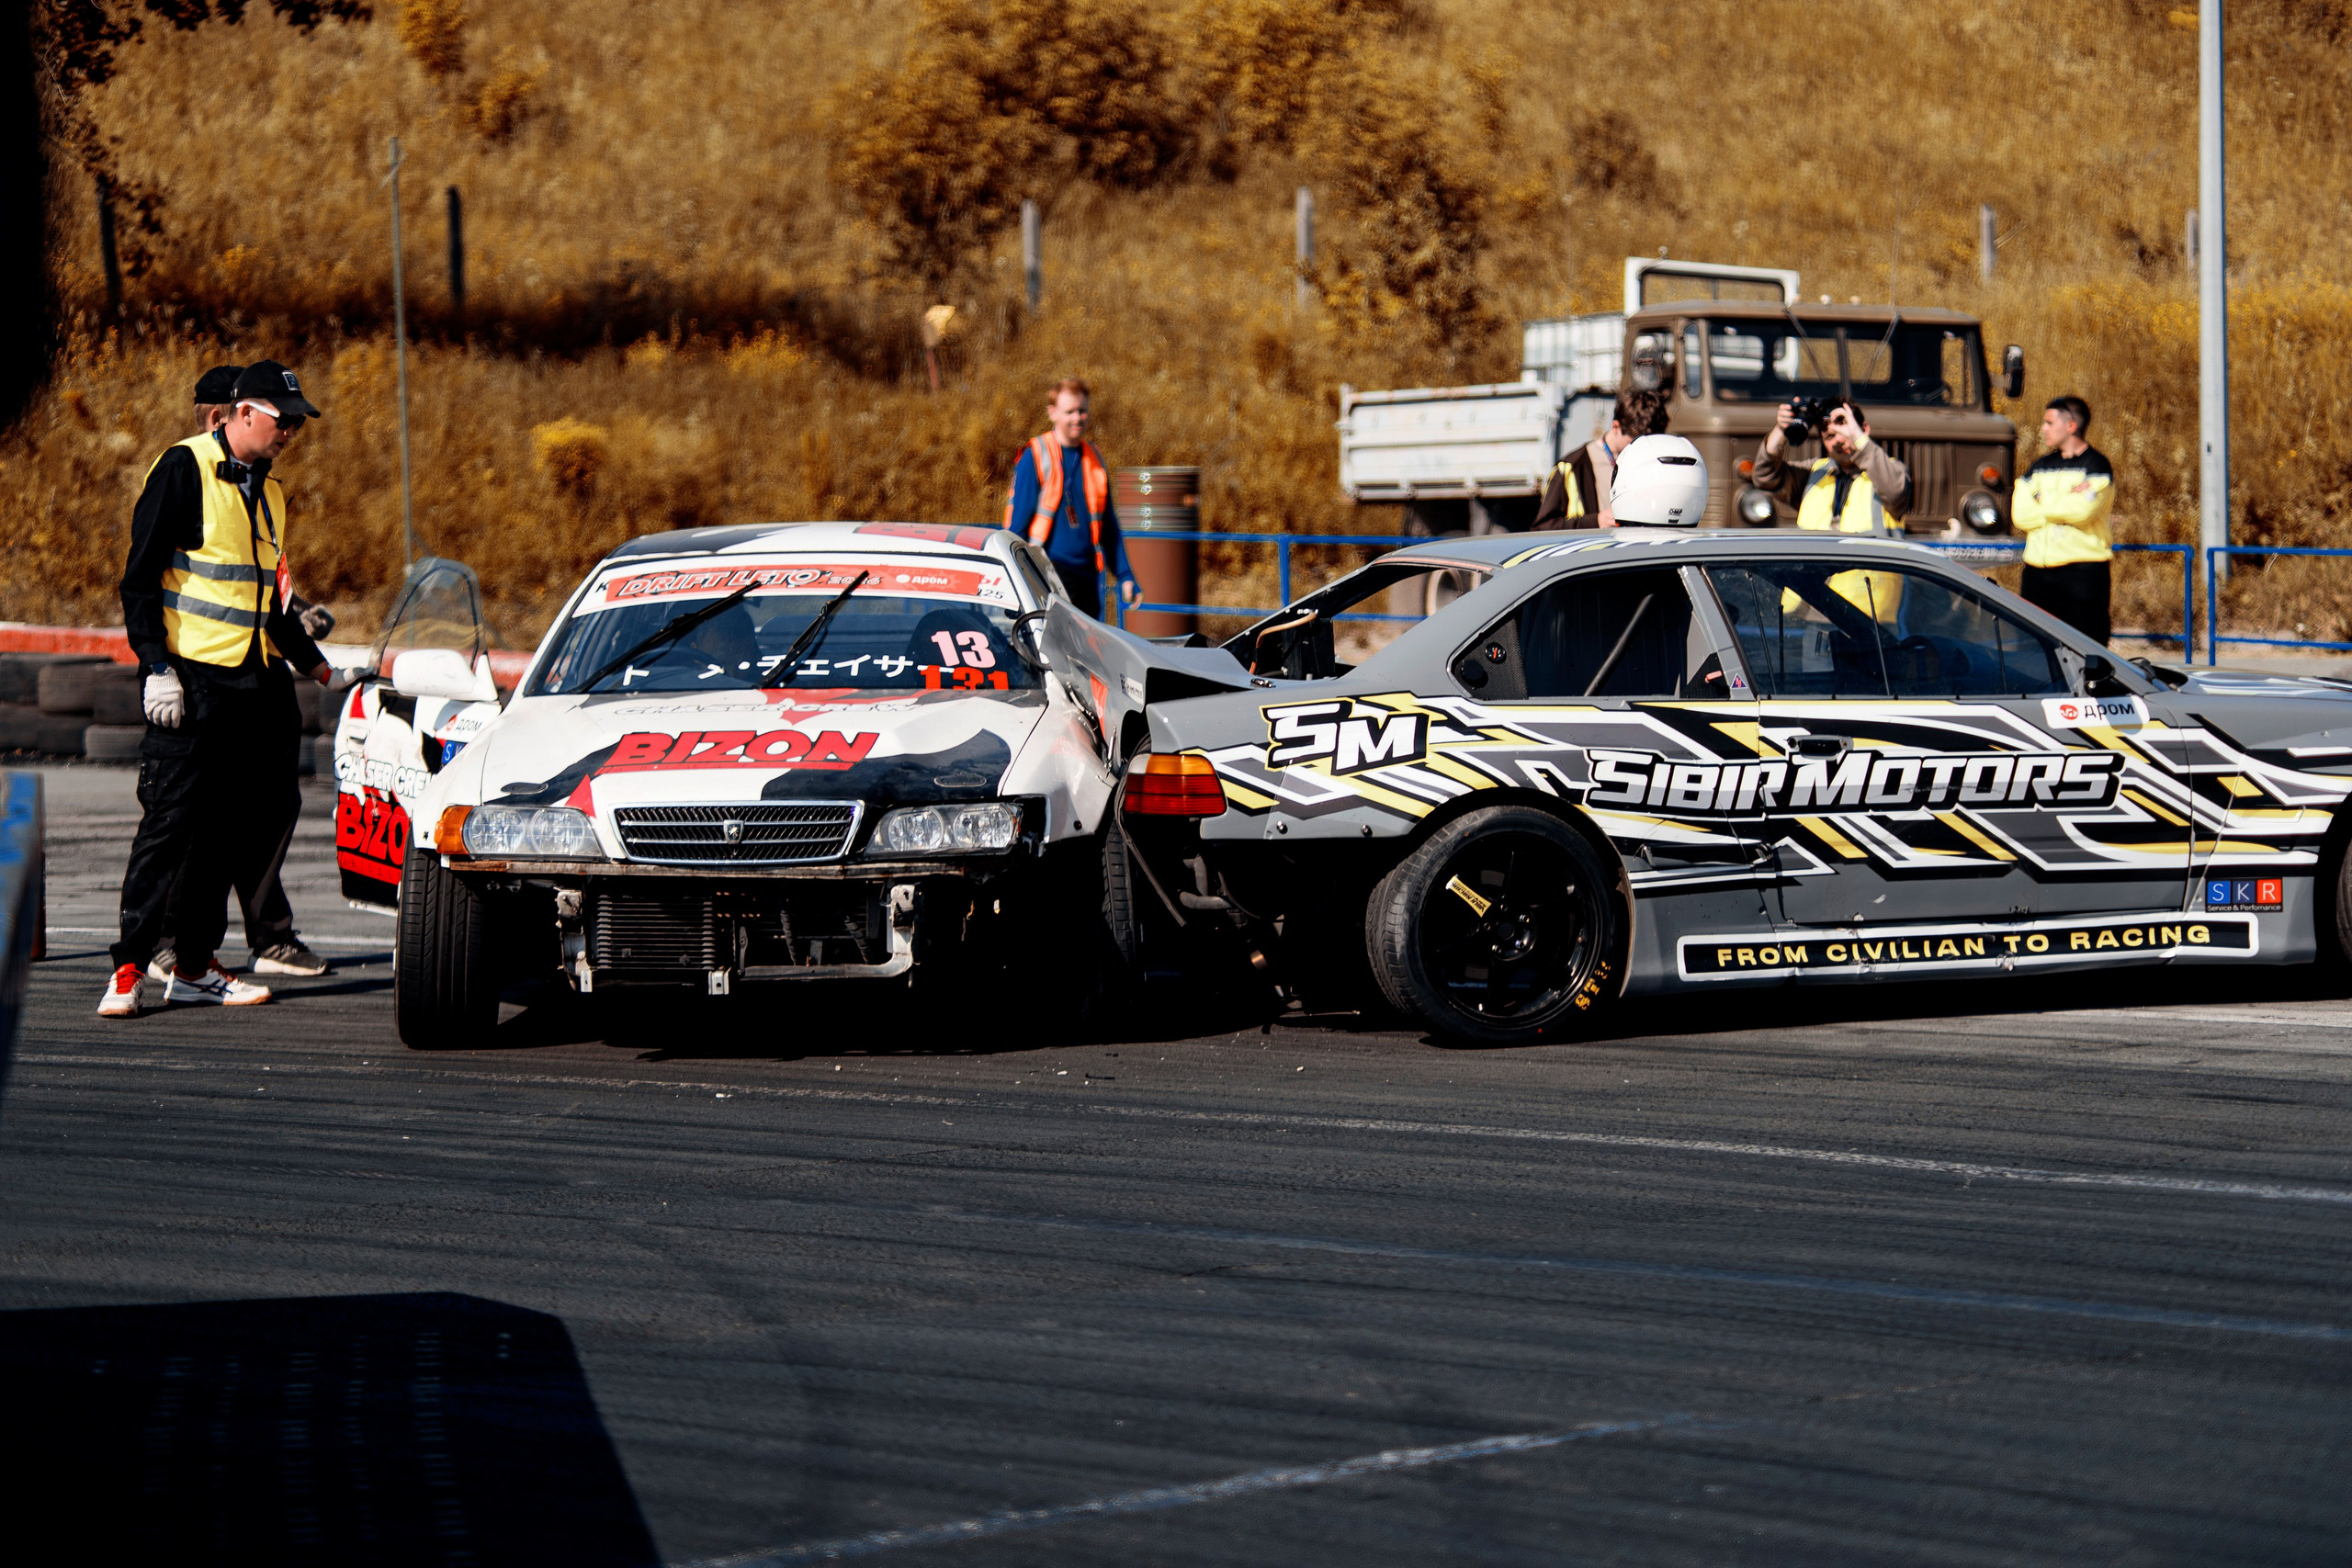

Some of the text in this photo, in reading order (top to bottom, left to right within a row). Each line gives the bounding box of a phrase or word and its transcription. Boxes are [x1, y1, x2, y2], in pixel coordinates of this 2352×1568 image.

[617, 571, 729, 597] DRIFT
[727, 569, 821, 587] LETO
[931, 631, 996, 668] 13
[604, 730, 880, 767] BIZON
[1267, 702, 1418, 771] SM
[1589, 750, 2115, 812] SIBIR MOTORS
[336, 792, 410, 866] BIZO
[2211, 882, 2277, 902] SKR
[1717, 925, 2211, 966] FROM CIVILIAN TO RACING
